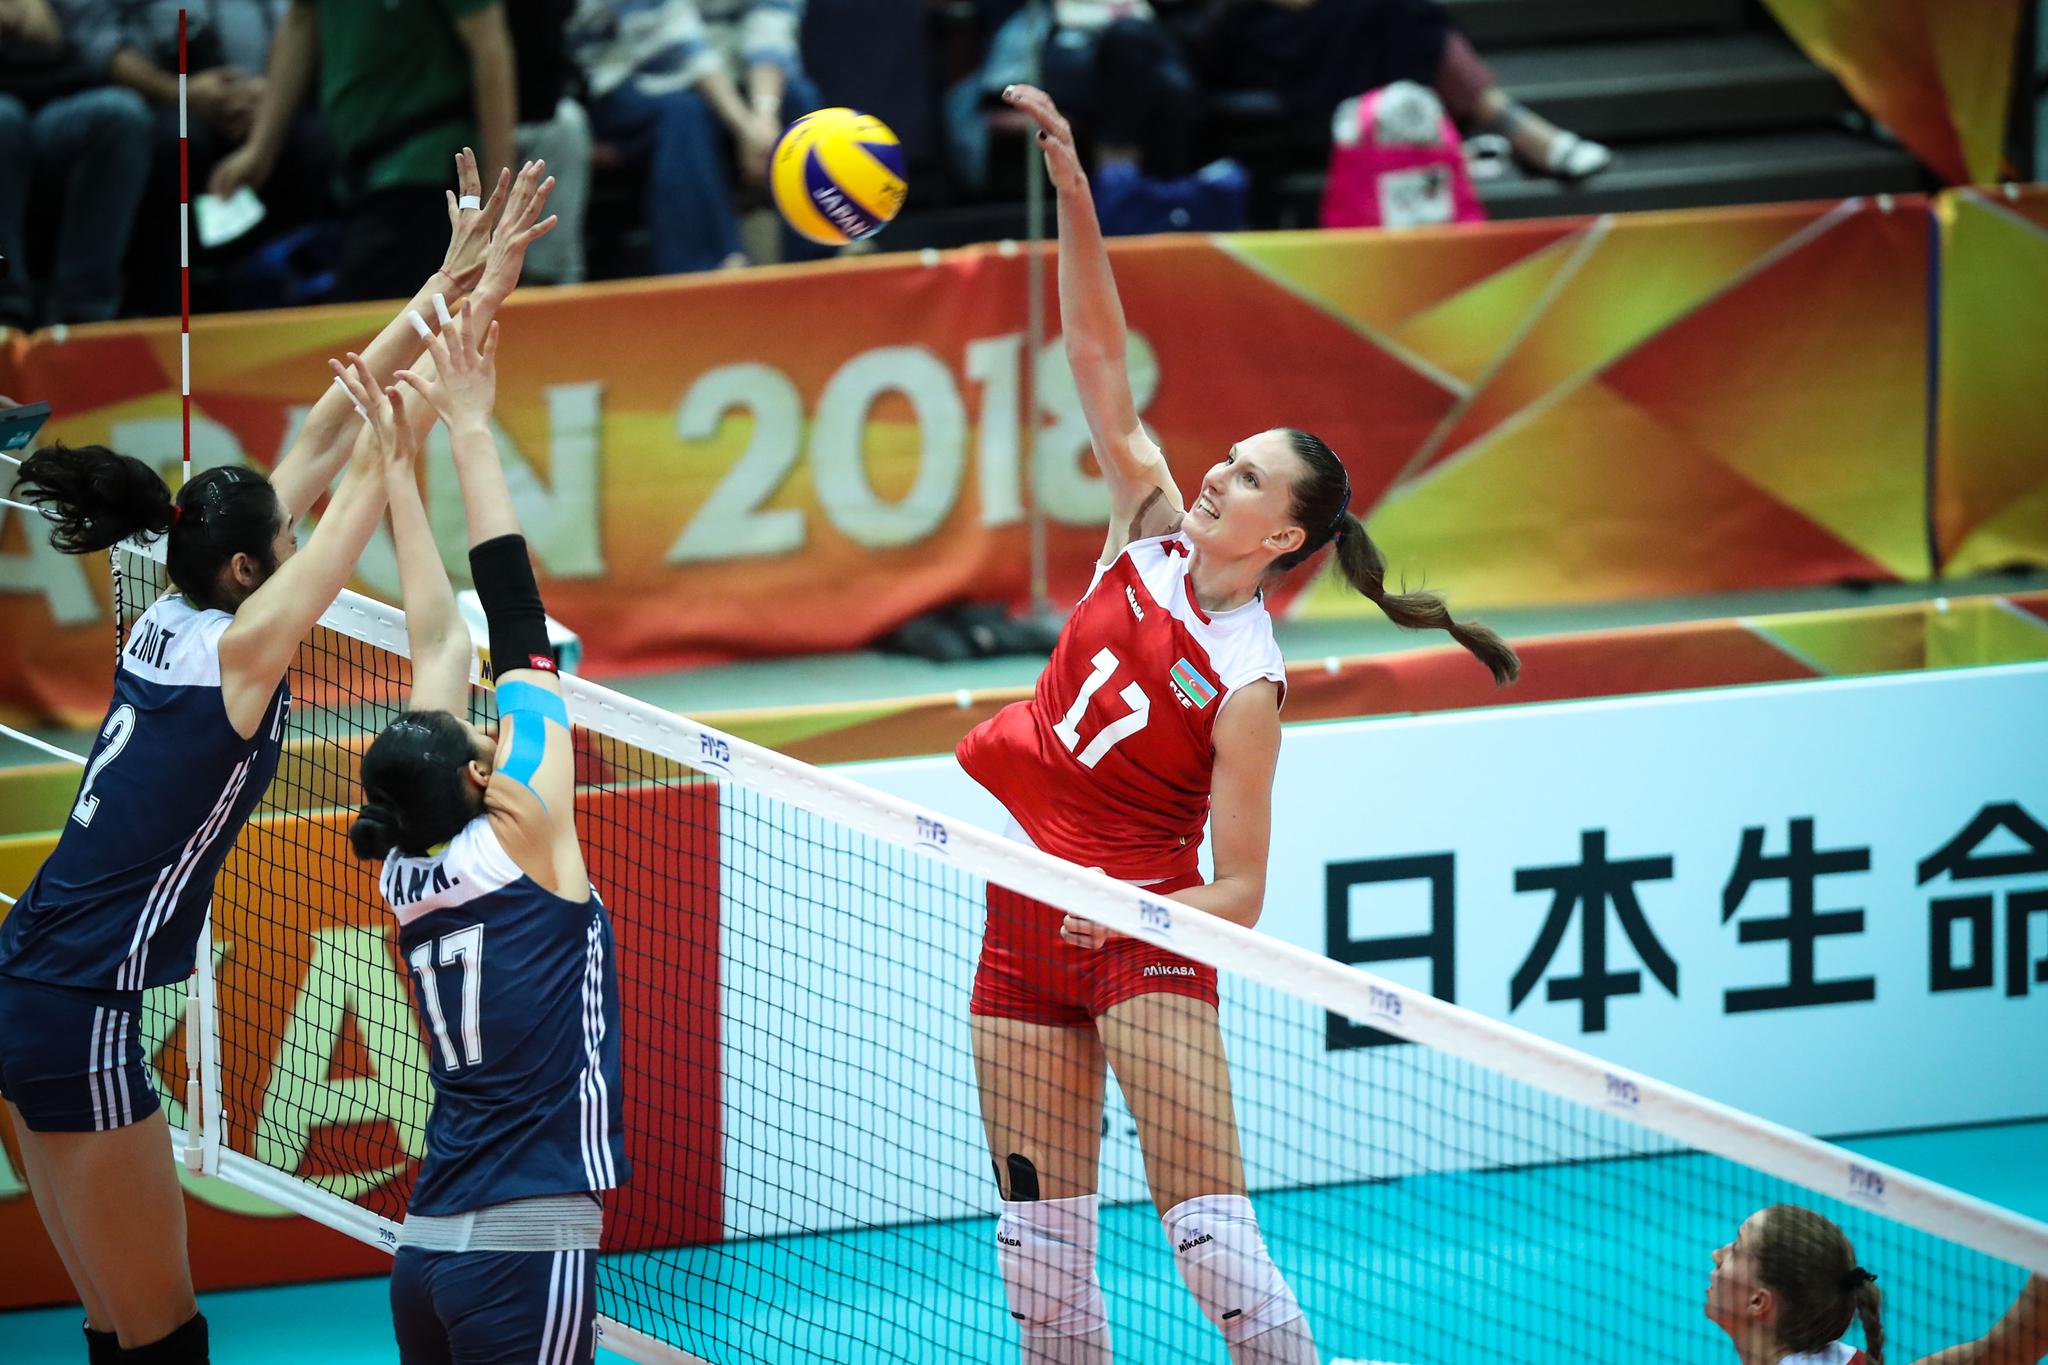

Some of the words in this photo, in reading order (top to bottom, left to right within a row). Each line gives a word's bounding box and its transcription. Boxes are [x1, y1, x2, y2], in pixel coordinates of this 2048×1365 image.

[812, 186, 872, 238] JAPAN
[666, 330, 1160, 566] 2018
[1052, 646, 1151, 769] 17
[1169, 680, 1193, 709] AZE
[71, 704, 137, 828] 2
[1143, 962, 1196, 977] MIKASA
[1325, 800, 2048, 1052] 日本生命
[409, 923, 485, 1071] 17
[1178, 1234, 1214, 1253] MIKASA
